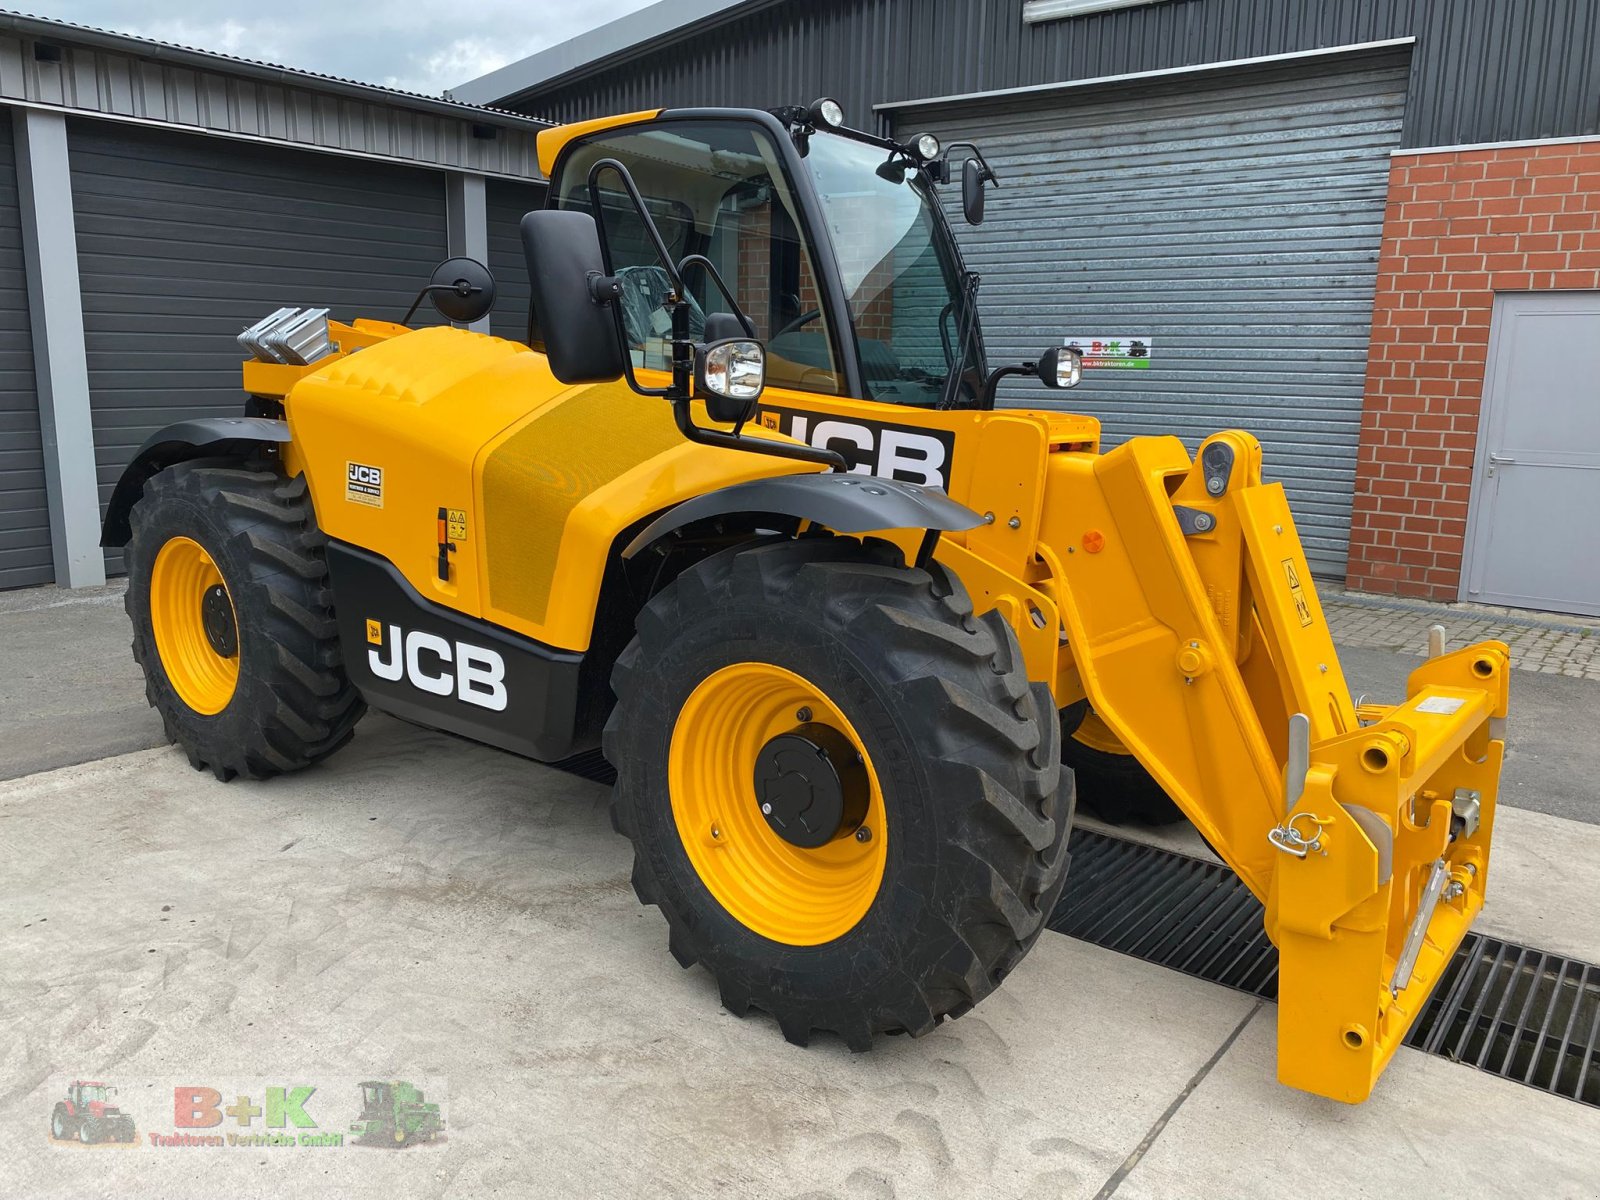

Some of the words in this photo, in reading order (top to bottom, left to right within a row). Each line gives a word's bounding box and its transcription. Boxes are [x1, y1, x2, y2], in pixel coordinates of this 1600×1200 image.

[1092, 341, 1121, 352] B+K
[350, 464, 380, 485] JCB
[368, 624, 508, 712] JCB
